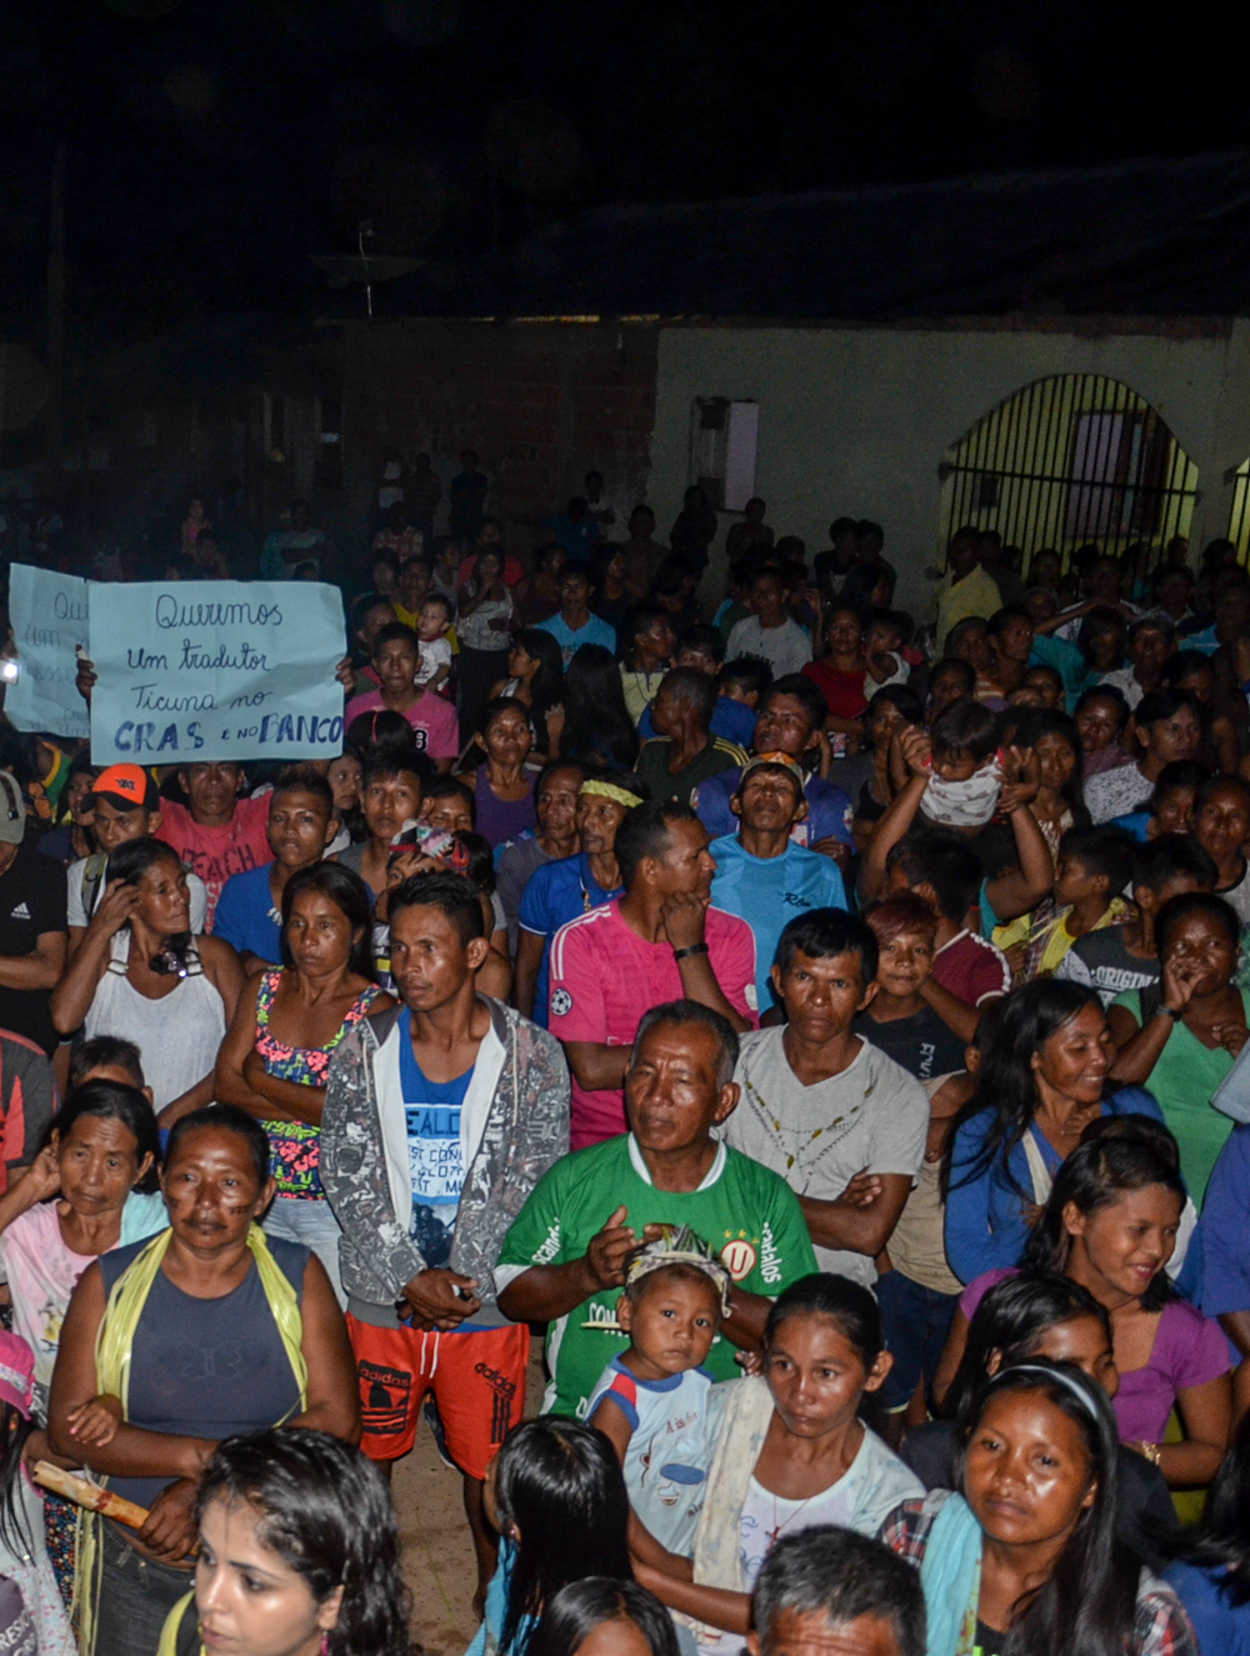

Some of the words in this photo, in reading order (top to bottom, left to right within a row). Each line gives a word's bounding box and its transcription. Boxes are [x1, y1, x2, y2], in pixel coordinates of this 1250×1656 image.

[155, 594, 284, 630] Queremos
[177, 637, 272, 672] tradutor
[130, 682, 220, 712] Ticuna
[228, 690, 274, 710] no
[113, 719, 206, 753] CRAS
[236, 724, 260, 740] NO
[258, 712, 344, 744] BANCO
[360, 1366, 410, 1387] adidas
[473, 1361, 517, 1401] adidas
